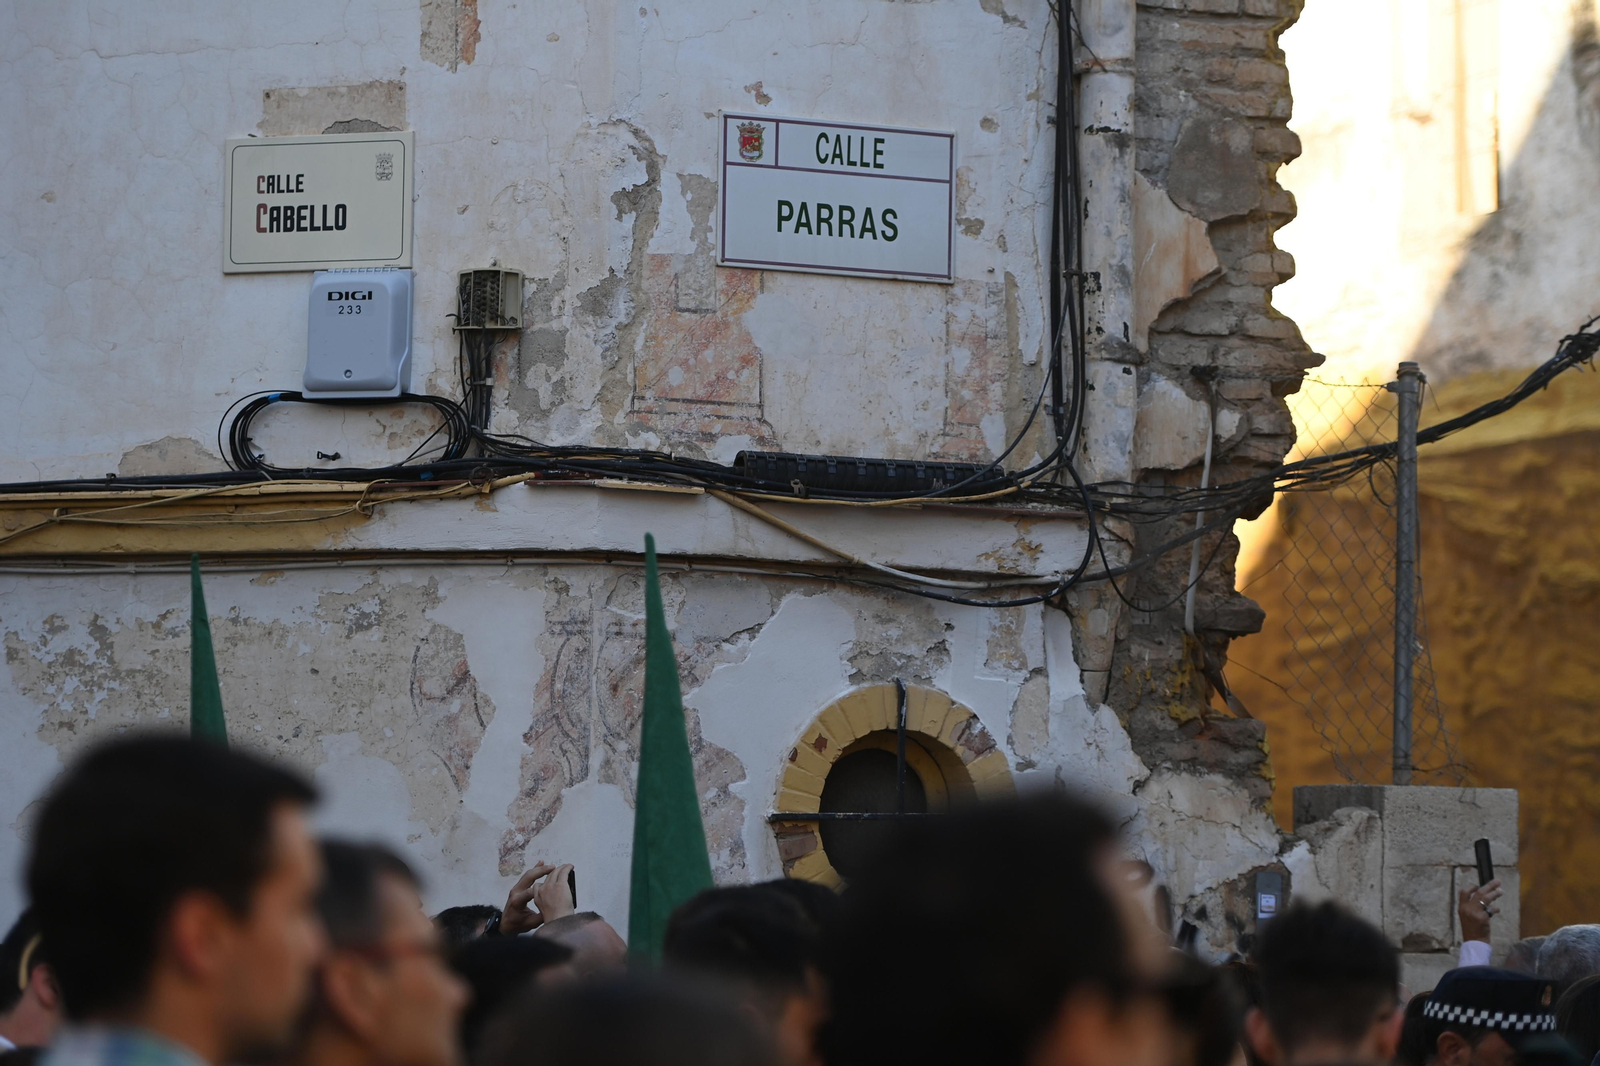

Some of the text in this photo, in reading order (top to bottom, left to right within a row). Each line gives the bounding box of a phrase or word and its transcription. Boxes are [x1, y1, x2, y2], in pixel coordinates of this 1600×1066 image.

[815, 132, 885, 169] CALLE
[256, 173, 305, 194] CALLE
[256, 203, 347, 233] CABELLO
[777, 199, 898, 242] PARRAS
[327, 290, 373, 301] DIGI
[338, 304, 362, 315] 233
